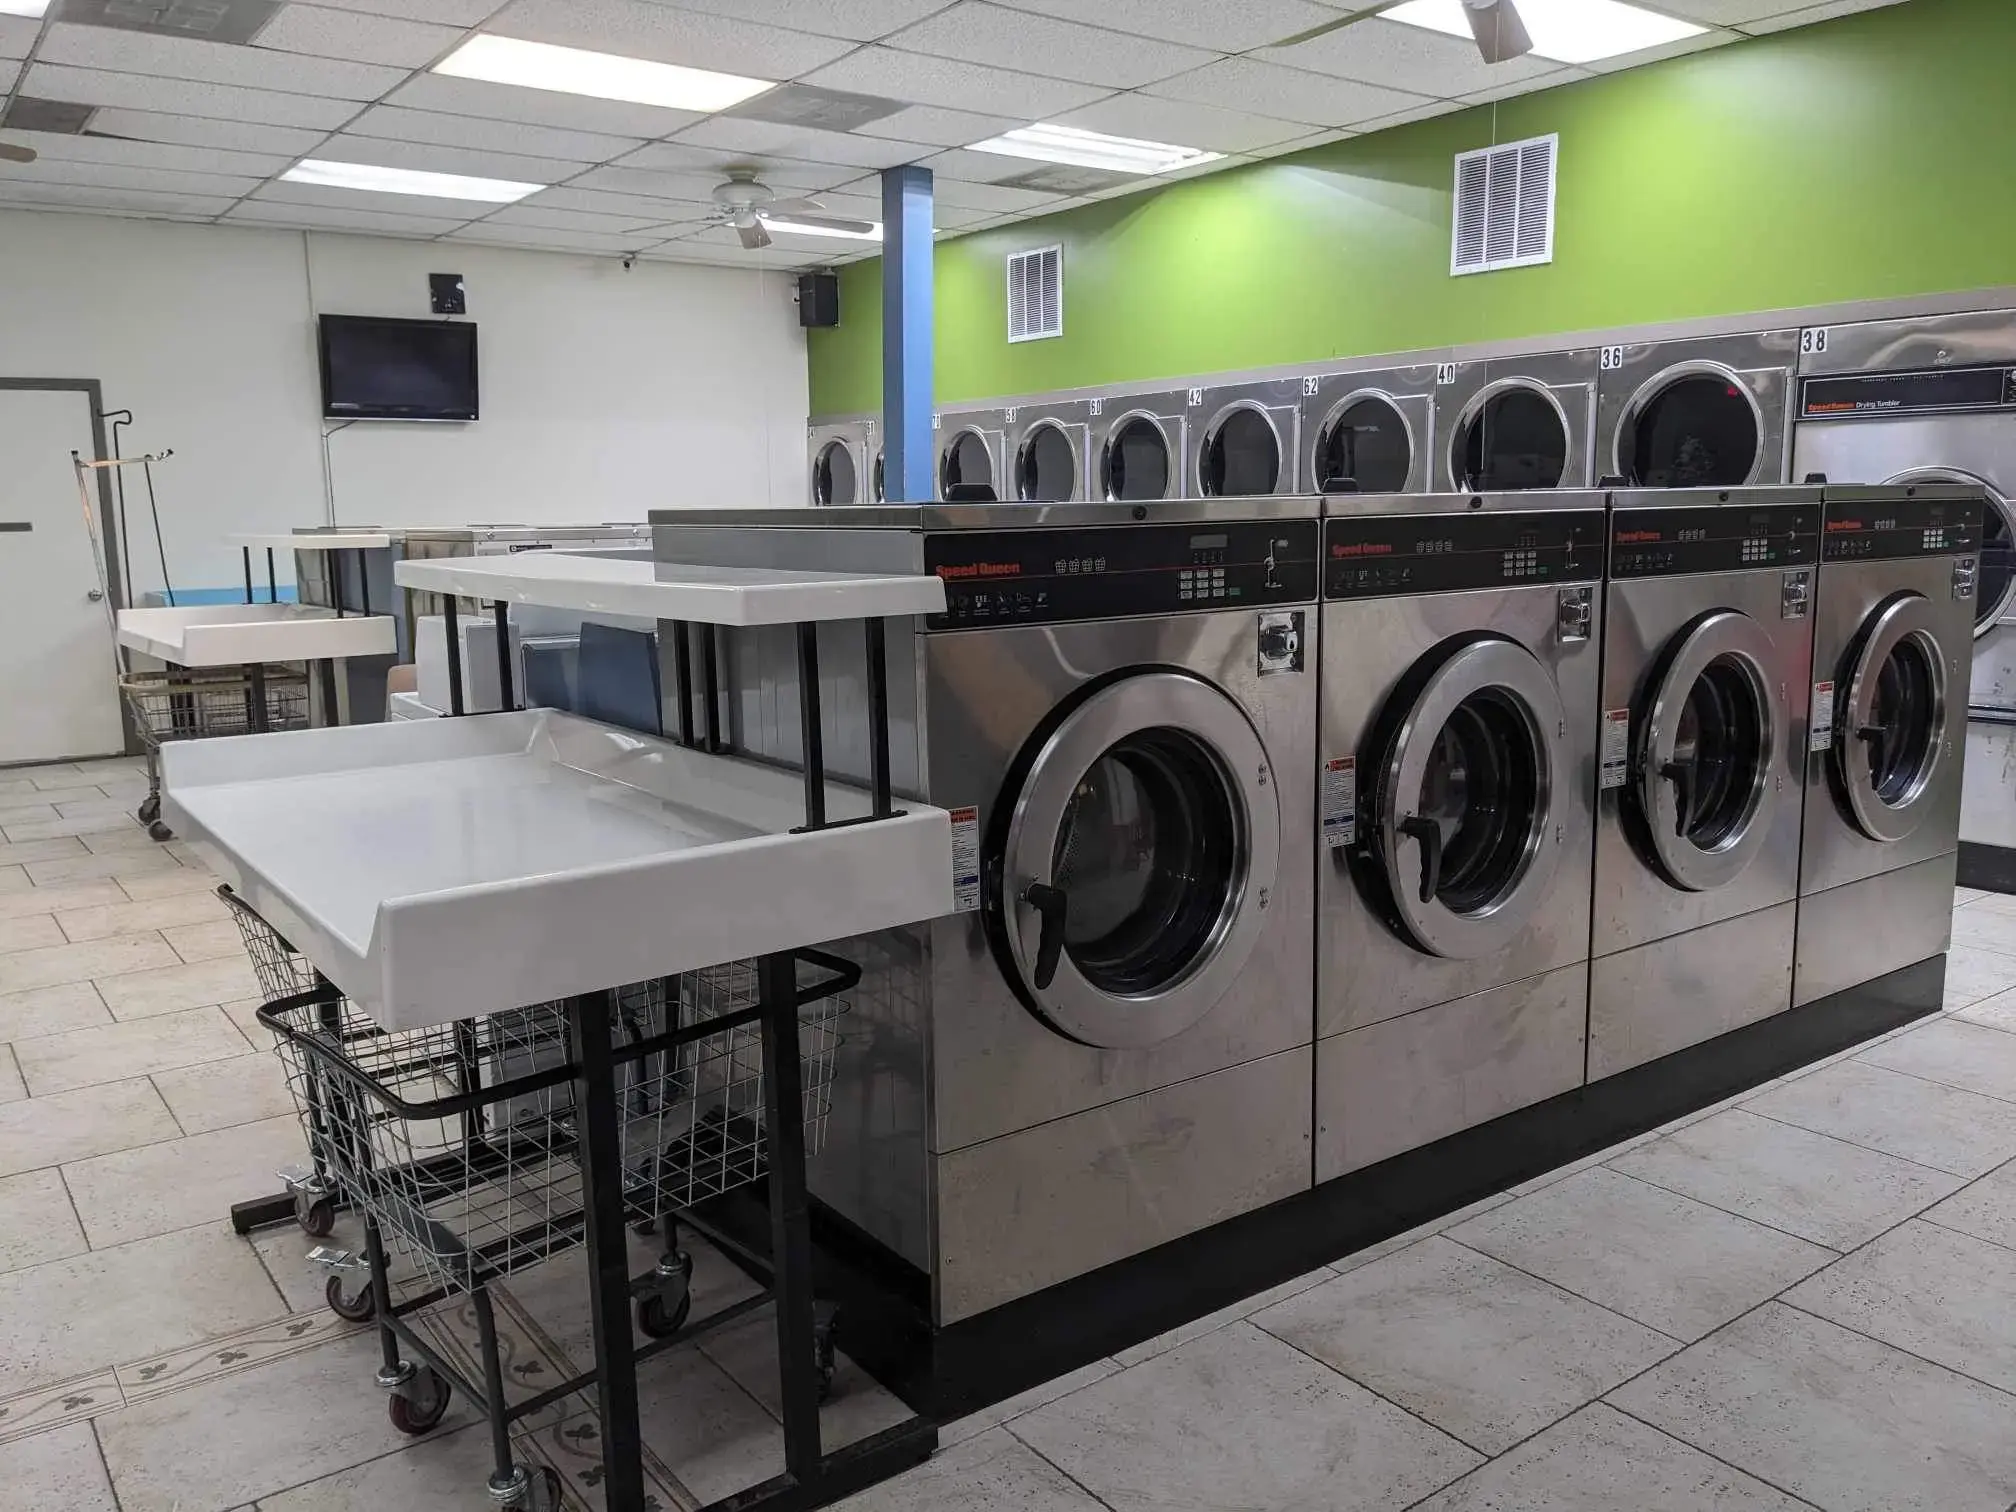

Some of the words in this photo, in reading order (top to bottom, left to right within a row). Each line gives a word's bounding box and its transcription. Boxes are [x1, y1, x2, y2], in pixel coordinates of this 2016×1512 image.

[1803, 328, 1826, 353] 38
[1602, 347, 1621, 369] 36
[1438, 364, 1455, 384] 40
[1303, 377, 1318, 395] 62
[1189, 388, 1202, 406] 42
[1856, 401, 1876, 410] Drying
[1877, 400, 1901, 408] Tumbler
[935, 563, 977, 580] Speed
[979, 561, 1020, 576] Queen
